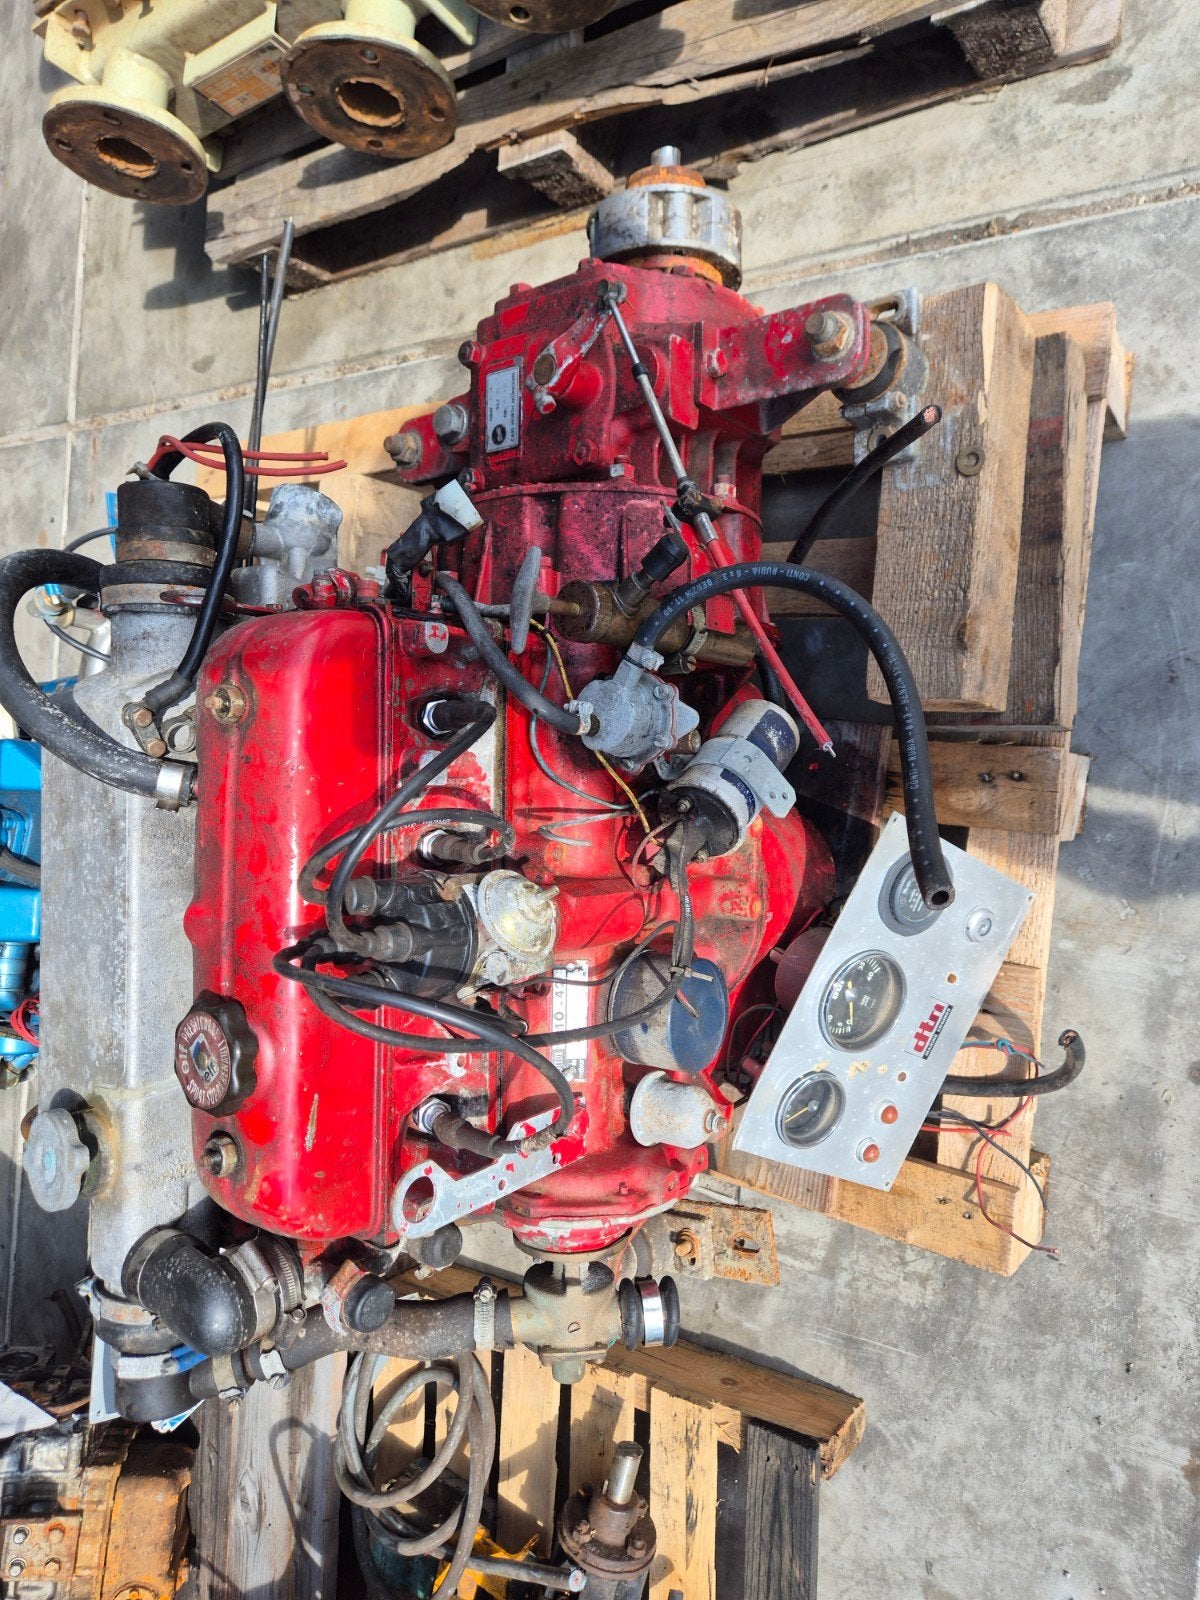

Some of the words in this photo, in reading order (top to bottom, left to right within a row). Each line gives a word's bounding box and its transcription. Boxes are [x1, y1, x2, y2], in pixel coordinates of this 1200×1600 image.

[867, 971, 874, 981] 40
[178, 1043, 190, 1075] elf
[203, 1061, 216, 1082] elf
